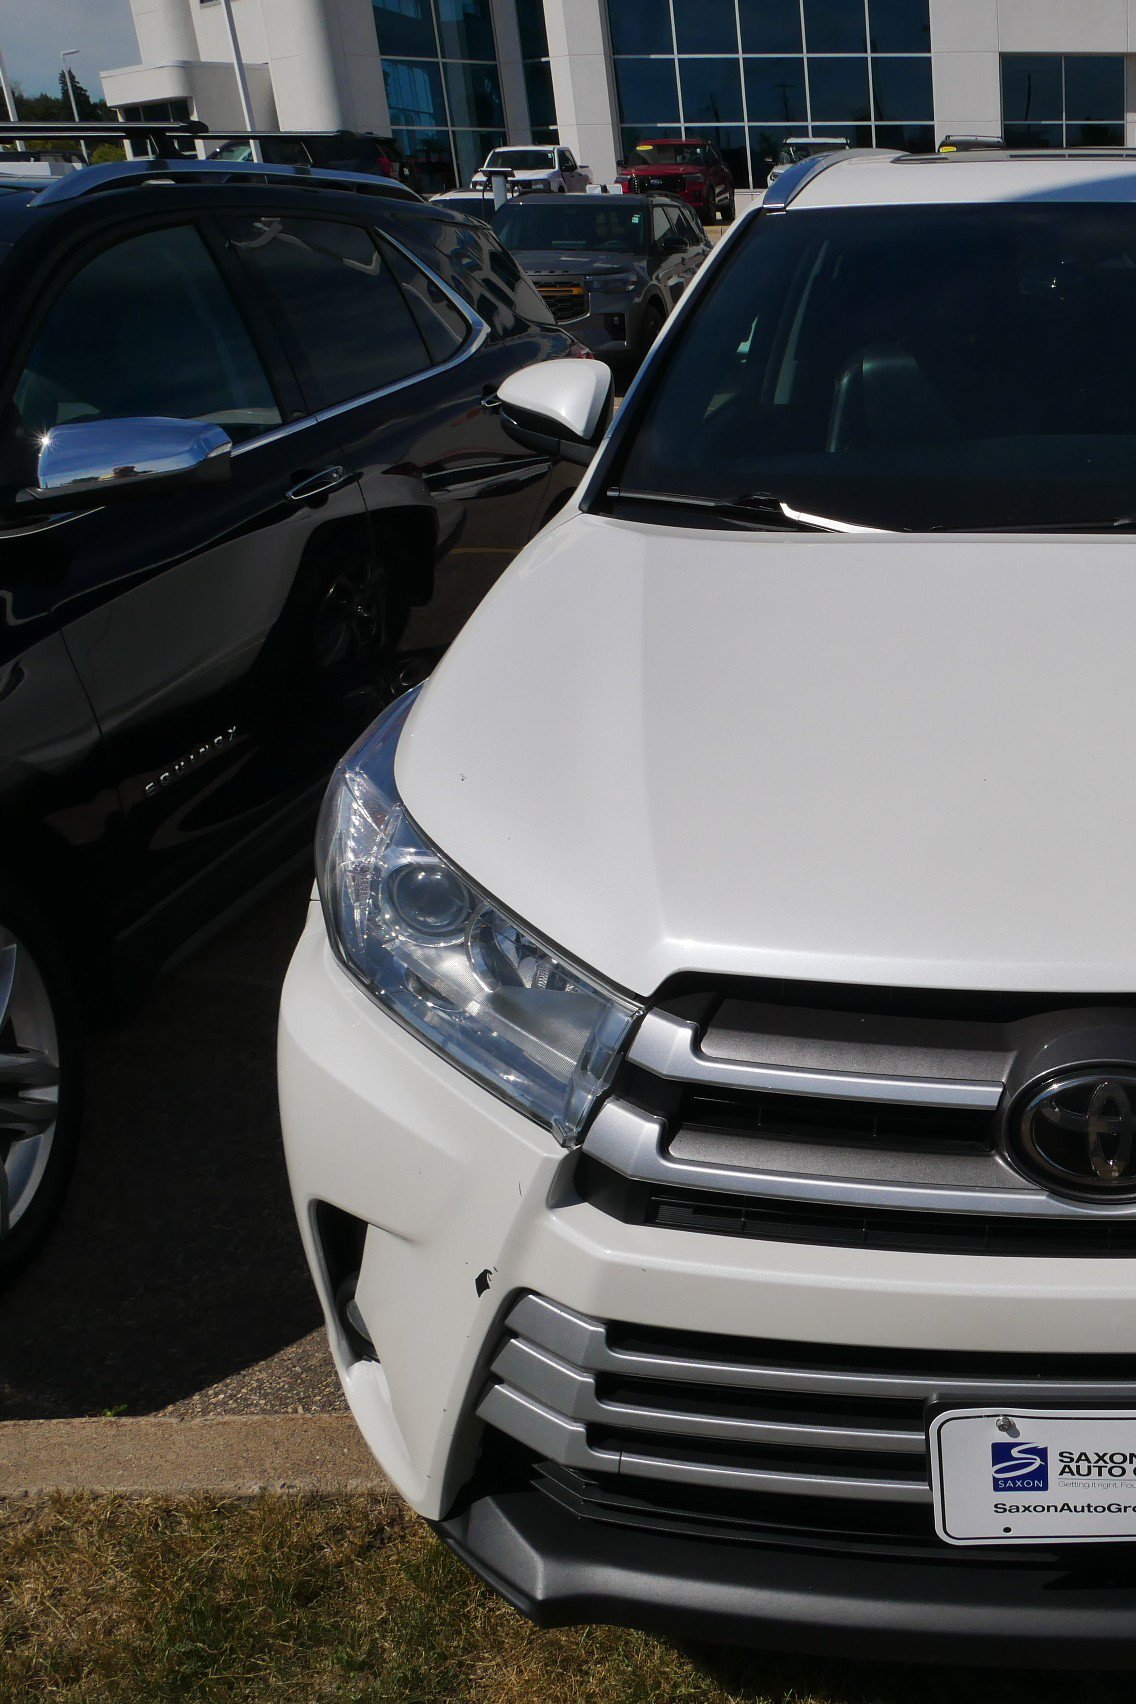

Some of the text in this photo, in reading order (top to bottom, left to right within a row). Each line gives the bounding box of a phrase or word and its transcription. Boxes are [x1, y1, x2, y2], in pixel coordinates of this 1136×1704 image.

[1058, 1464, 1127, 1478] AUTO
[998, 1480, 1044, 1488] SAXON
[1058, 1480, 1090, 1490] Getting
